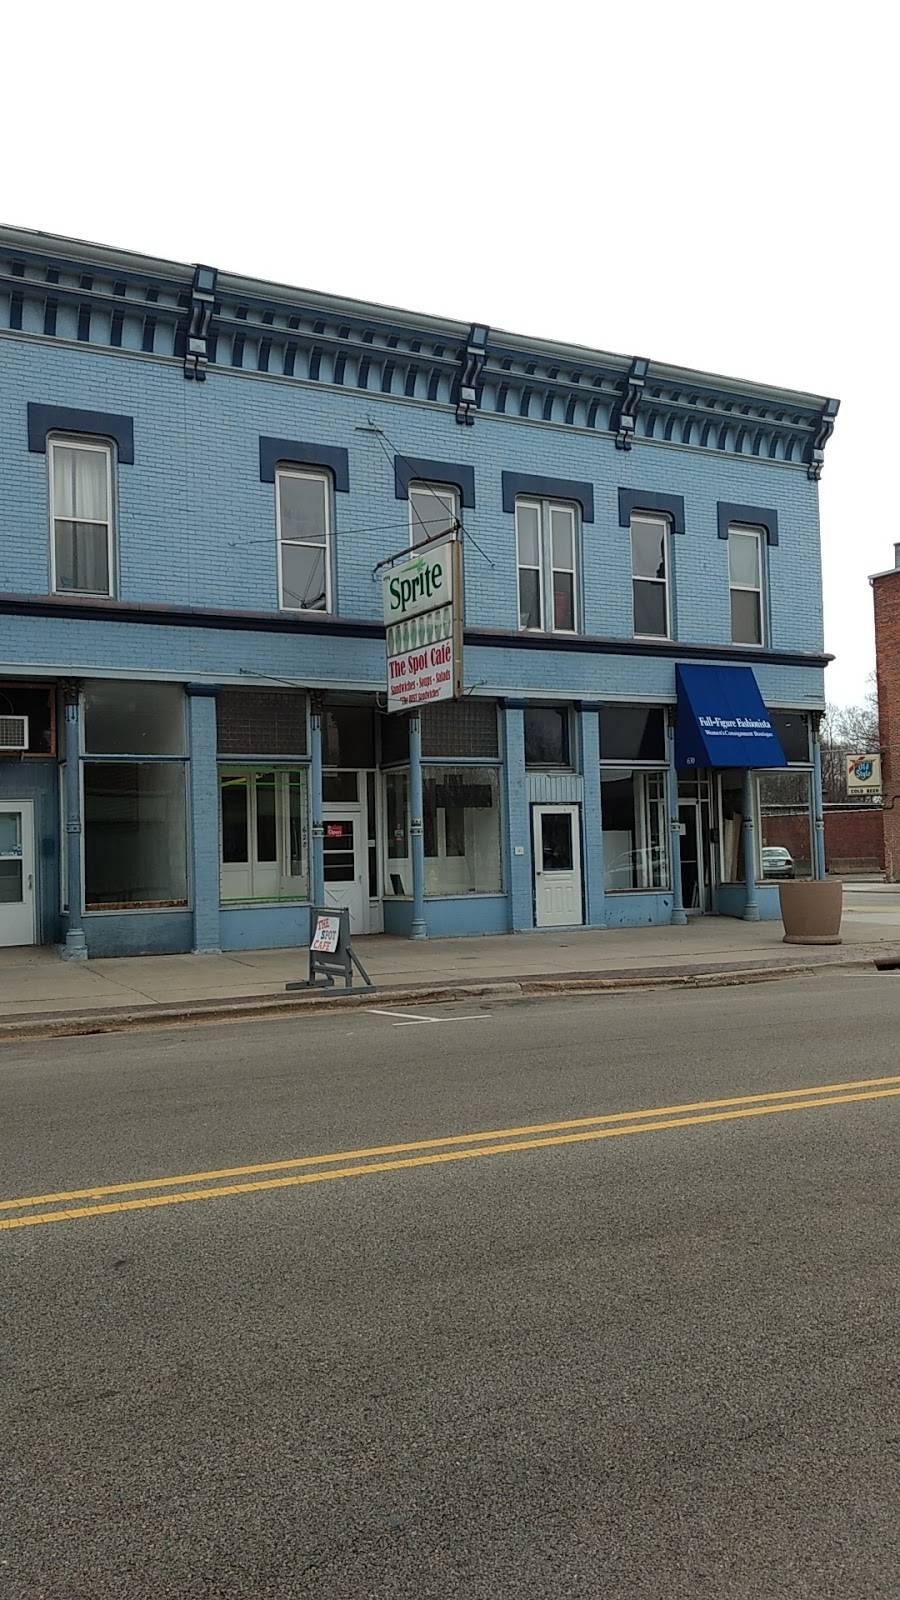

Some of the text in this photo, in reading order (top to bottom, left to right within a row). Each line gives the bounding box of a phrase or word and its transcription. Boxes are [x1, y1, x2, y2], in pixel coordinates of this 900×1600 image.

[390, 563, 442, 612] Sprite
[388, 641, 452, 679] The Spot Café
[390, 669, 451, 695] Sandwiches Soups Salads
[698, 716, 736, 729] Full-Figure
[856, 770, 871, 779] Style
[318, 918, 330, 930] THE
[320, 930, 337, 941] SPOT
[313, 940, 332, 951] CAFE
